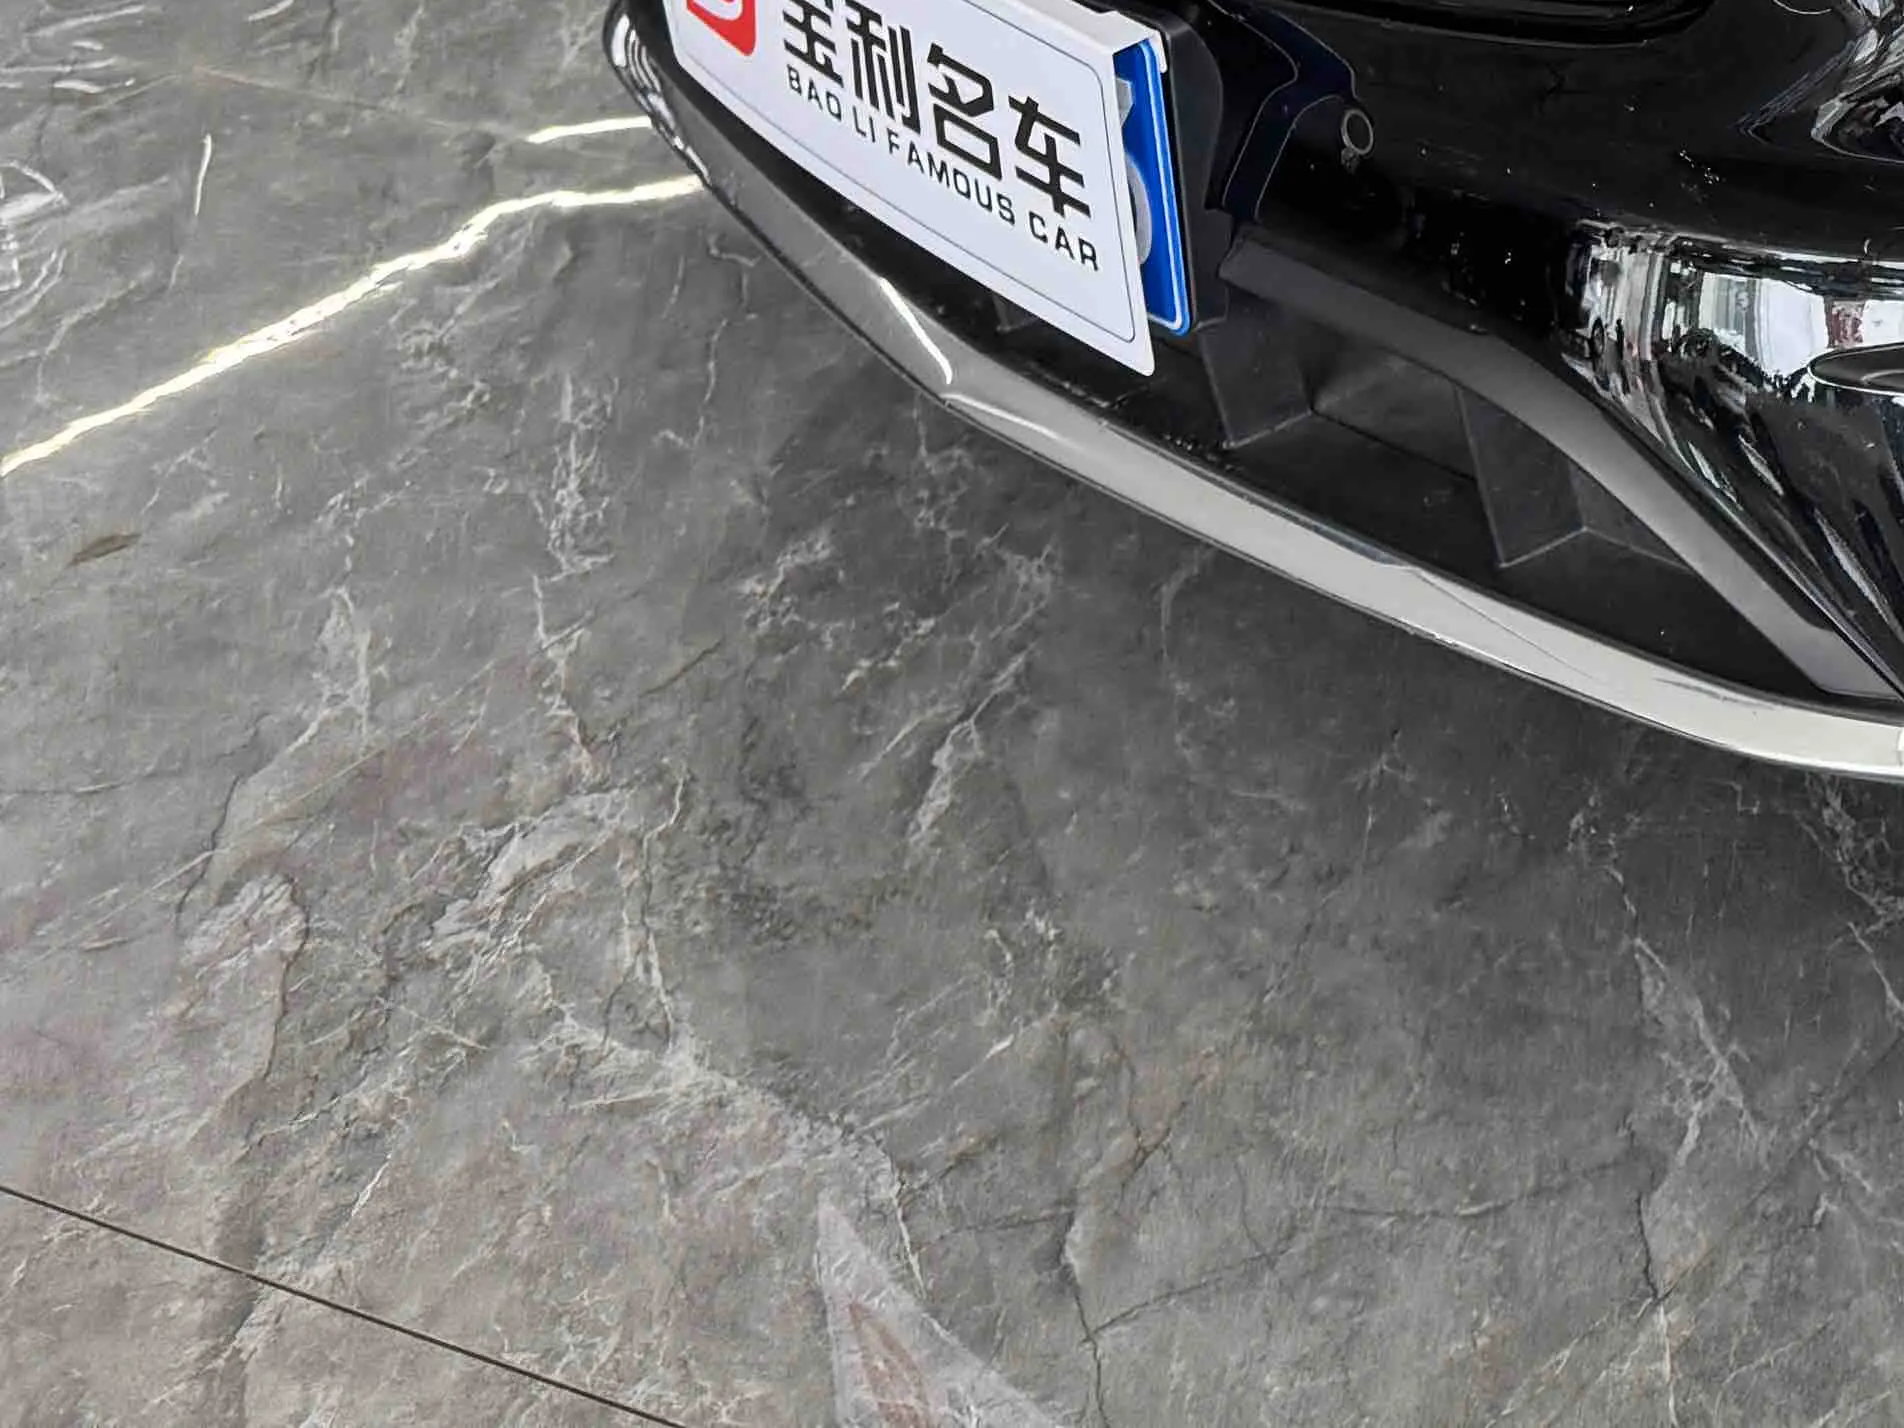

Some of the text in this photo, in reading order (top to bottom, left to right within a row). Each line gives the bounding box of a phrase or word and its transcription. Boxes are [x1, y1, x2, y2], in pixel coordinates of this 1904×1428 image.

[786, 63, 1101, 273] BAO LI FAMOUS CAR
